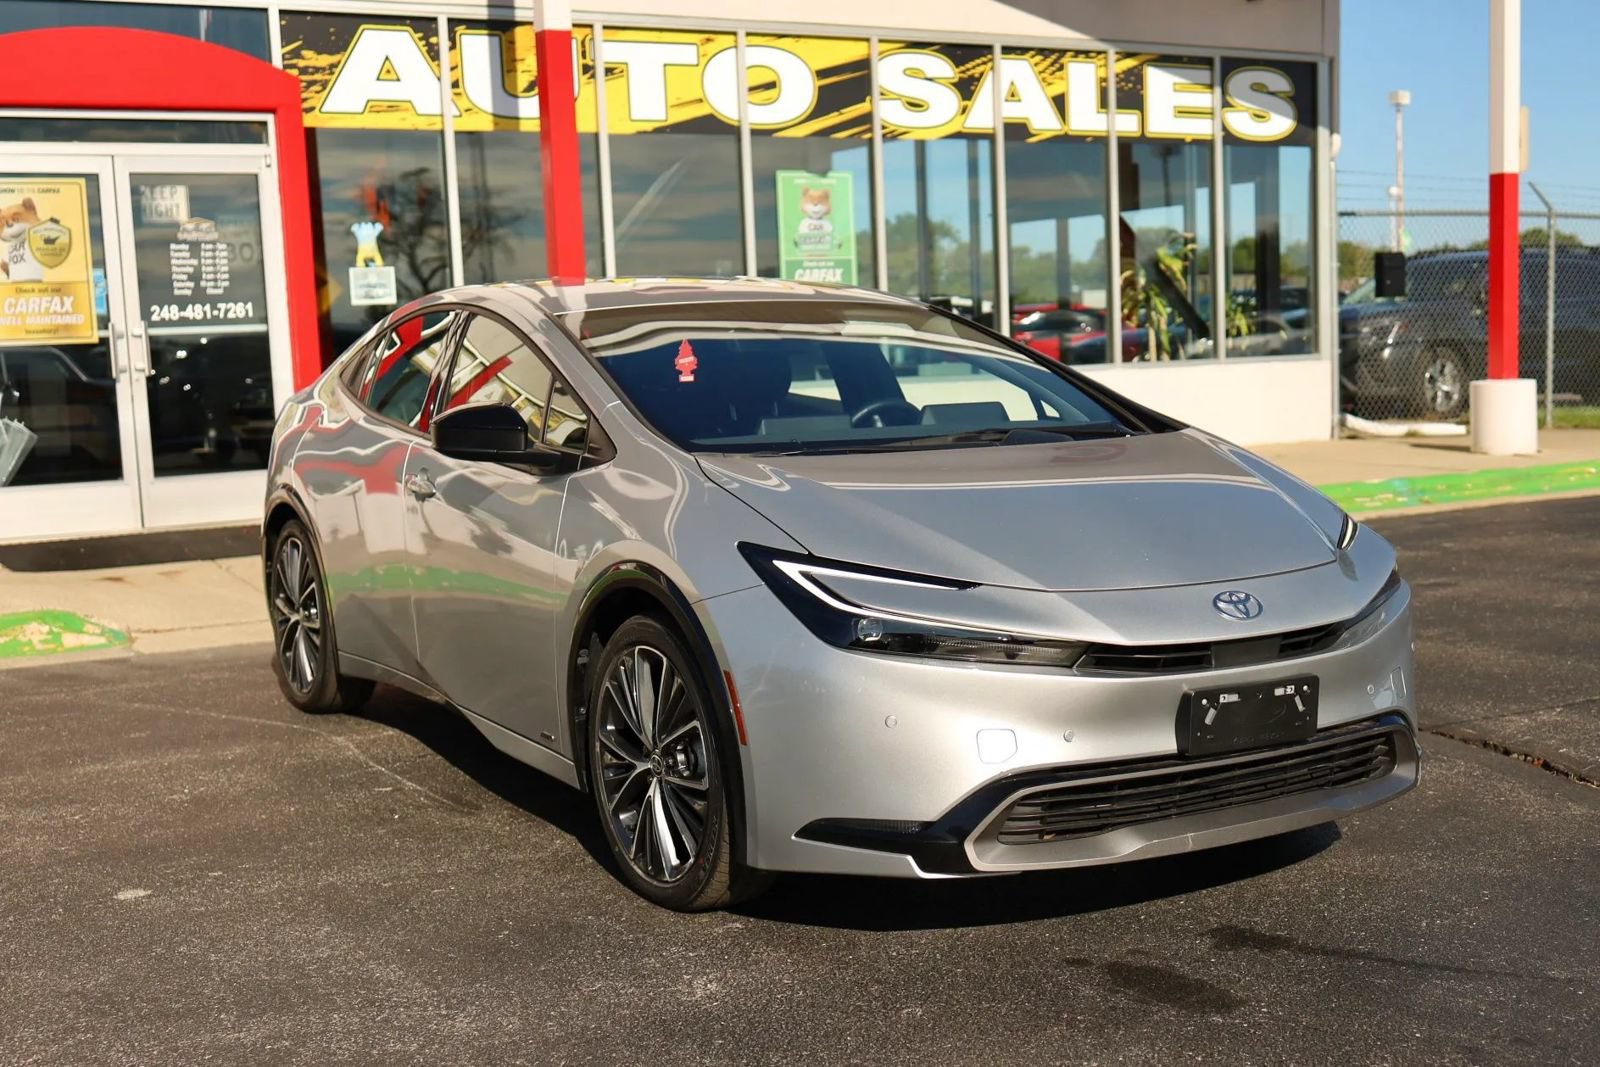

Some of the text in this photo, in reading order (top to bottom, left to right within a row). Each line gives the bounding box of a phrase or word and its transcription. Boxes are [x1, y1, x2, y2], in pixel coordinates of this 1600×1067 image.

[319, 25, 1298, 141] AUTO SALES
[4, 296, 74, 314] CARFAX
[150, 301, 253, 321] 248-481-7261
